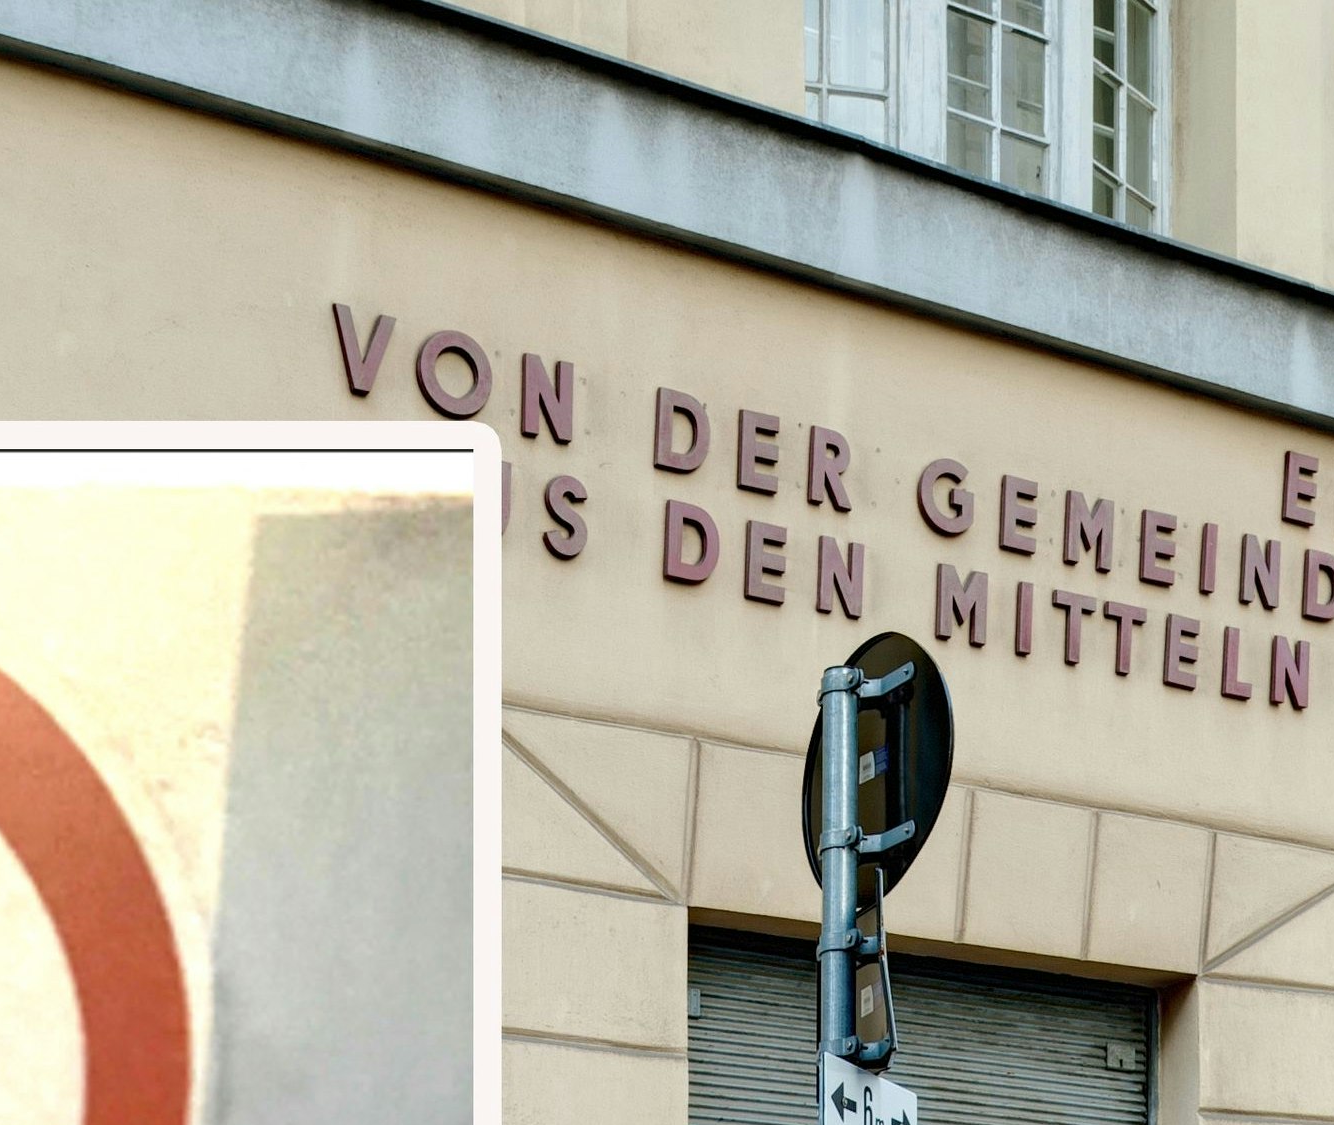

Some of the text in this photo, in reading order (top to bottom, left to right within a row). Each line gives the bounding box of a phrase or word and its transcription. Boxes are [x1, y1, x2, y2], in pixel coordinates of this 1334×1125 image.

[331, 302, 575, 445] VON
[653, 386, 852, 513] DER
[502, 461, 589, 561] S
[662, 498, 866, 621] DEN
[934, 562, 1311, 711] MITTELN
